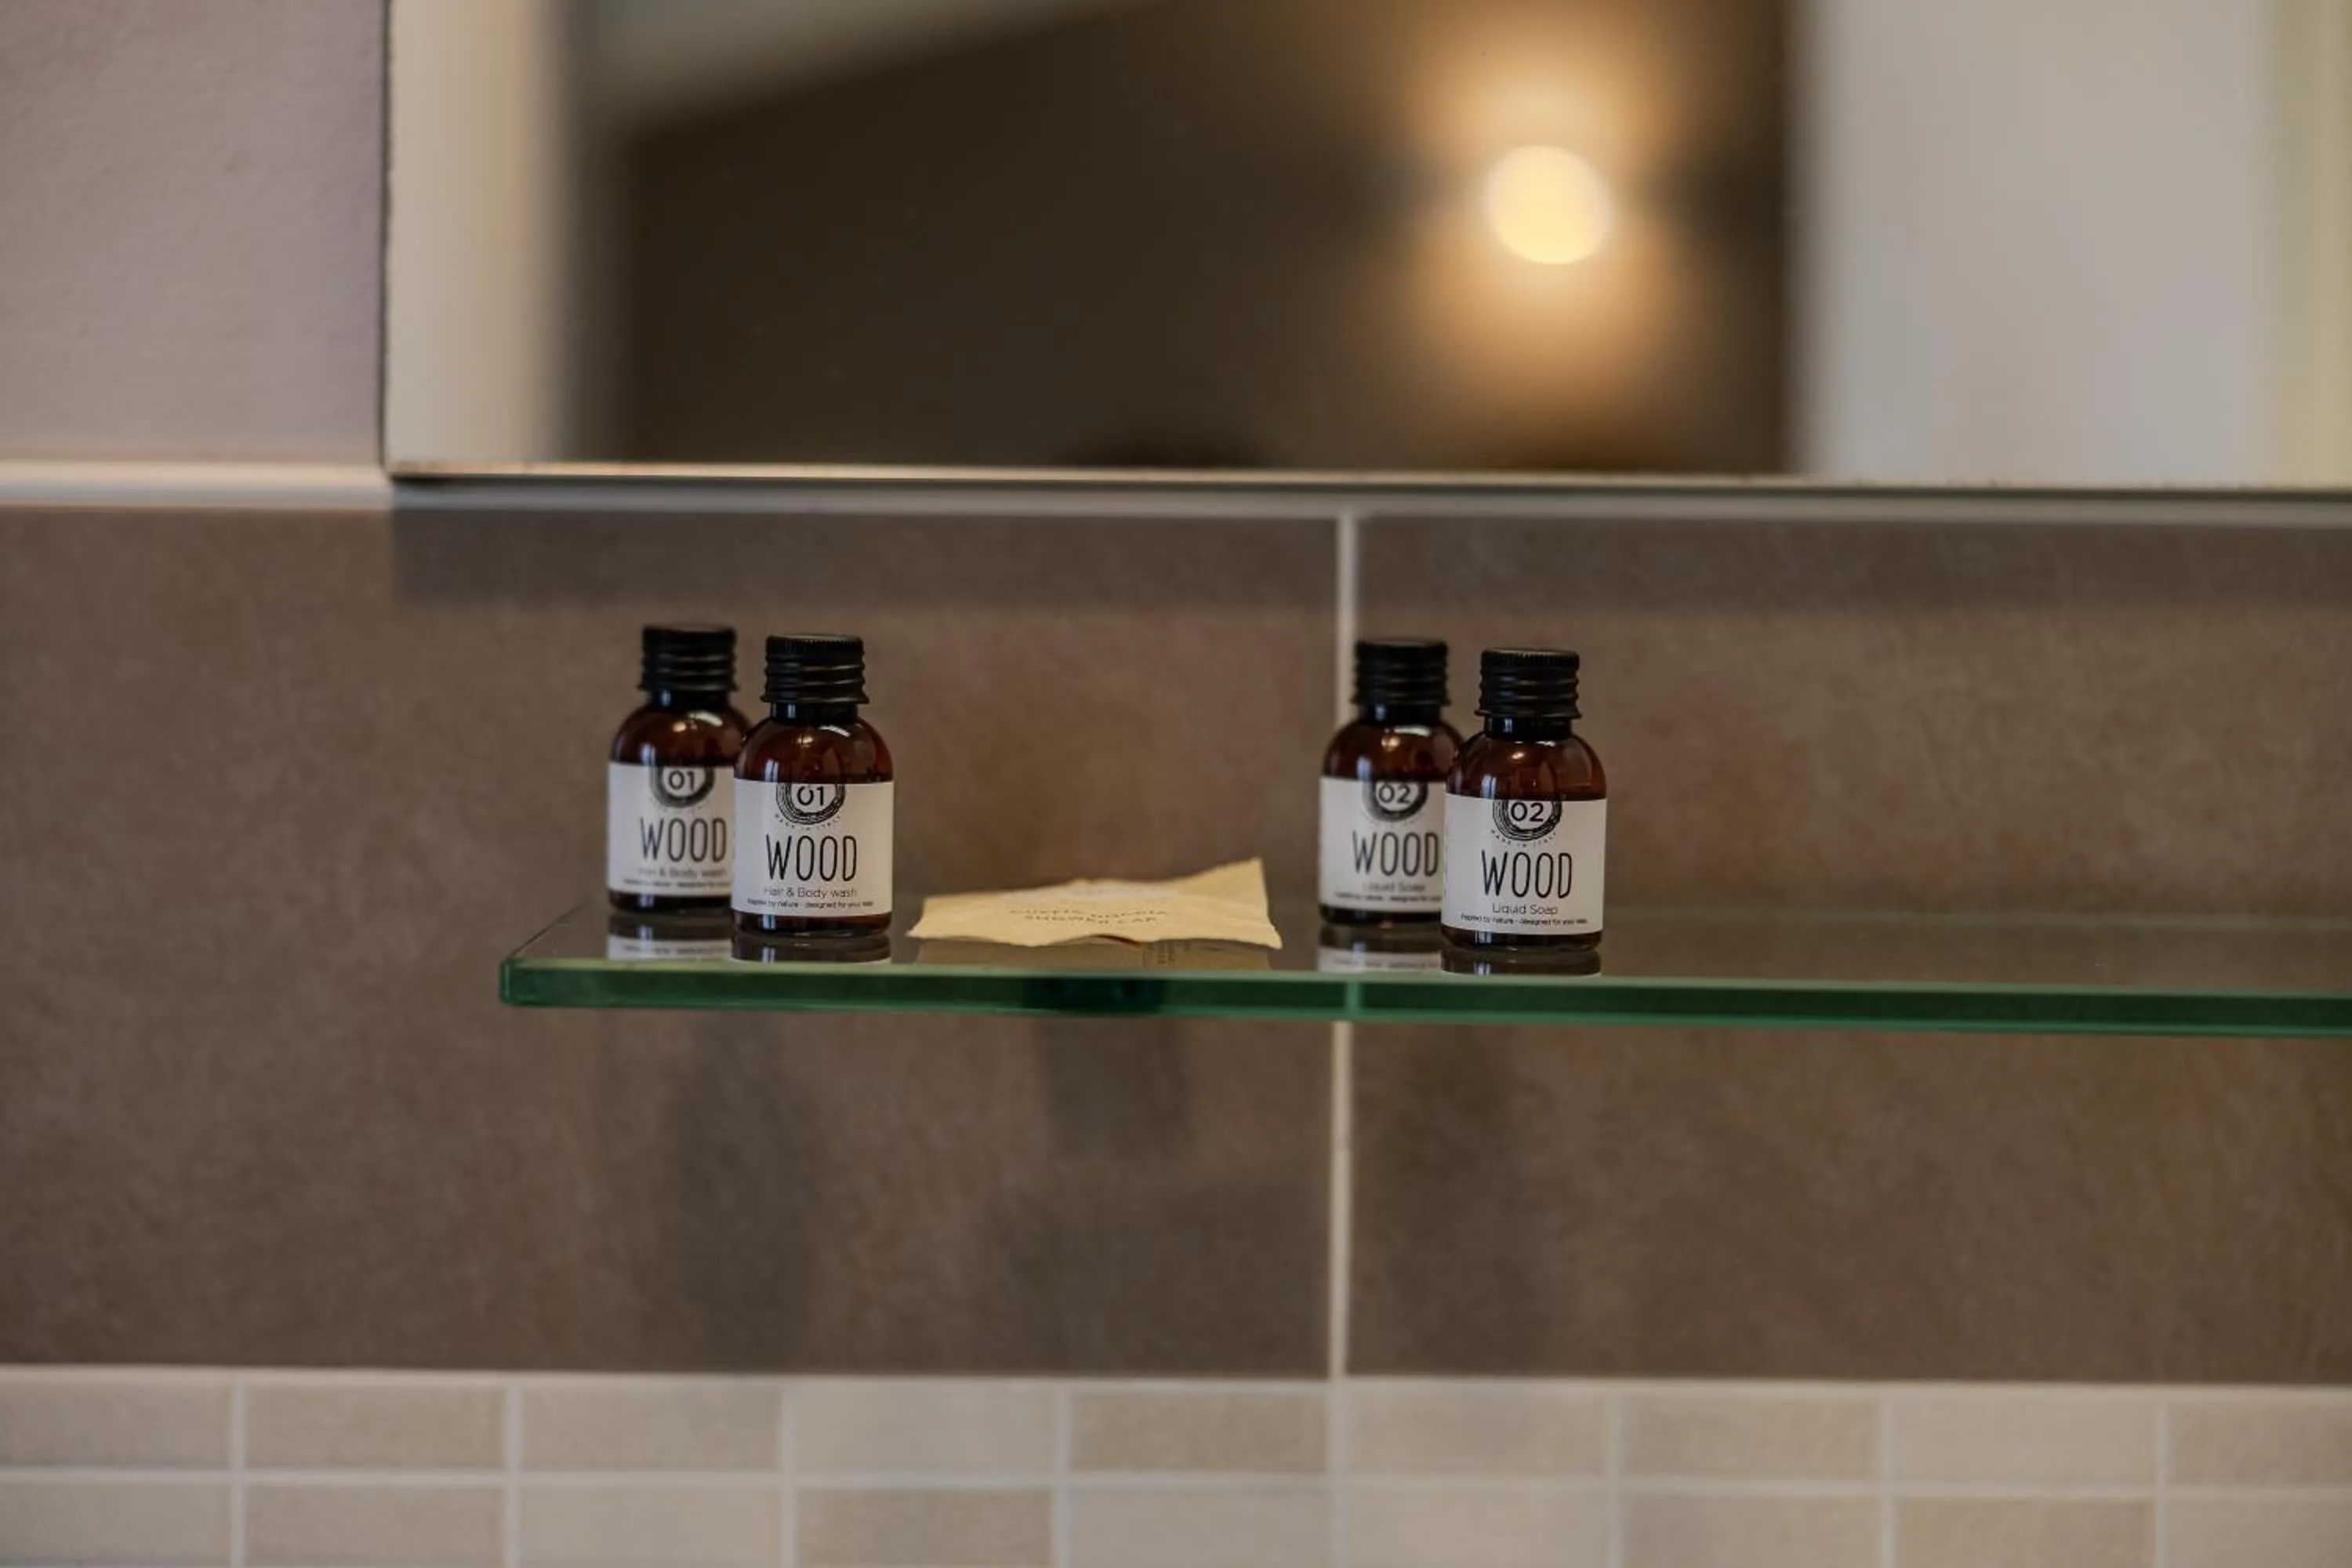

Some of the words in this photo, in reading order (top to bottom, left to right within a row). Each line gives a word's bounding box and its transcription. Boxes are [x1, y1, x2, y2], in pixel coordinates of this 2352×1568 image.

[640, 816, 727, 863] WOOD
[766, 834, 857, 881] WOOD
[1352, 830, 1439, 877] WOOD
[797, 887, 826, 899] Body
[830, 887, 857, 897] wash
[1482, 850, 1572, 898] WOOD
[1493, 904, 1526, 915] Liquid
[1530, 904, 1559, 916] Soap
